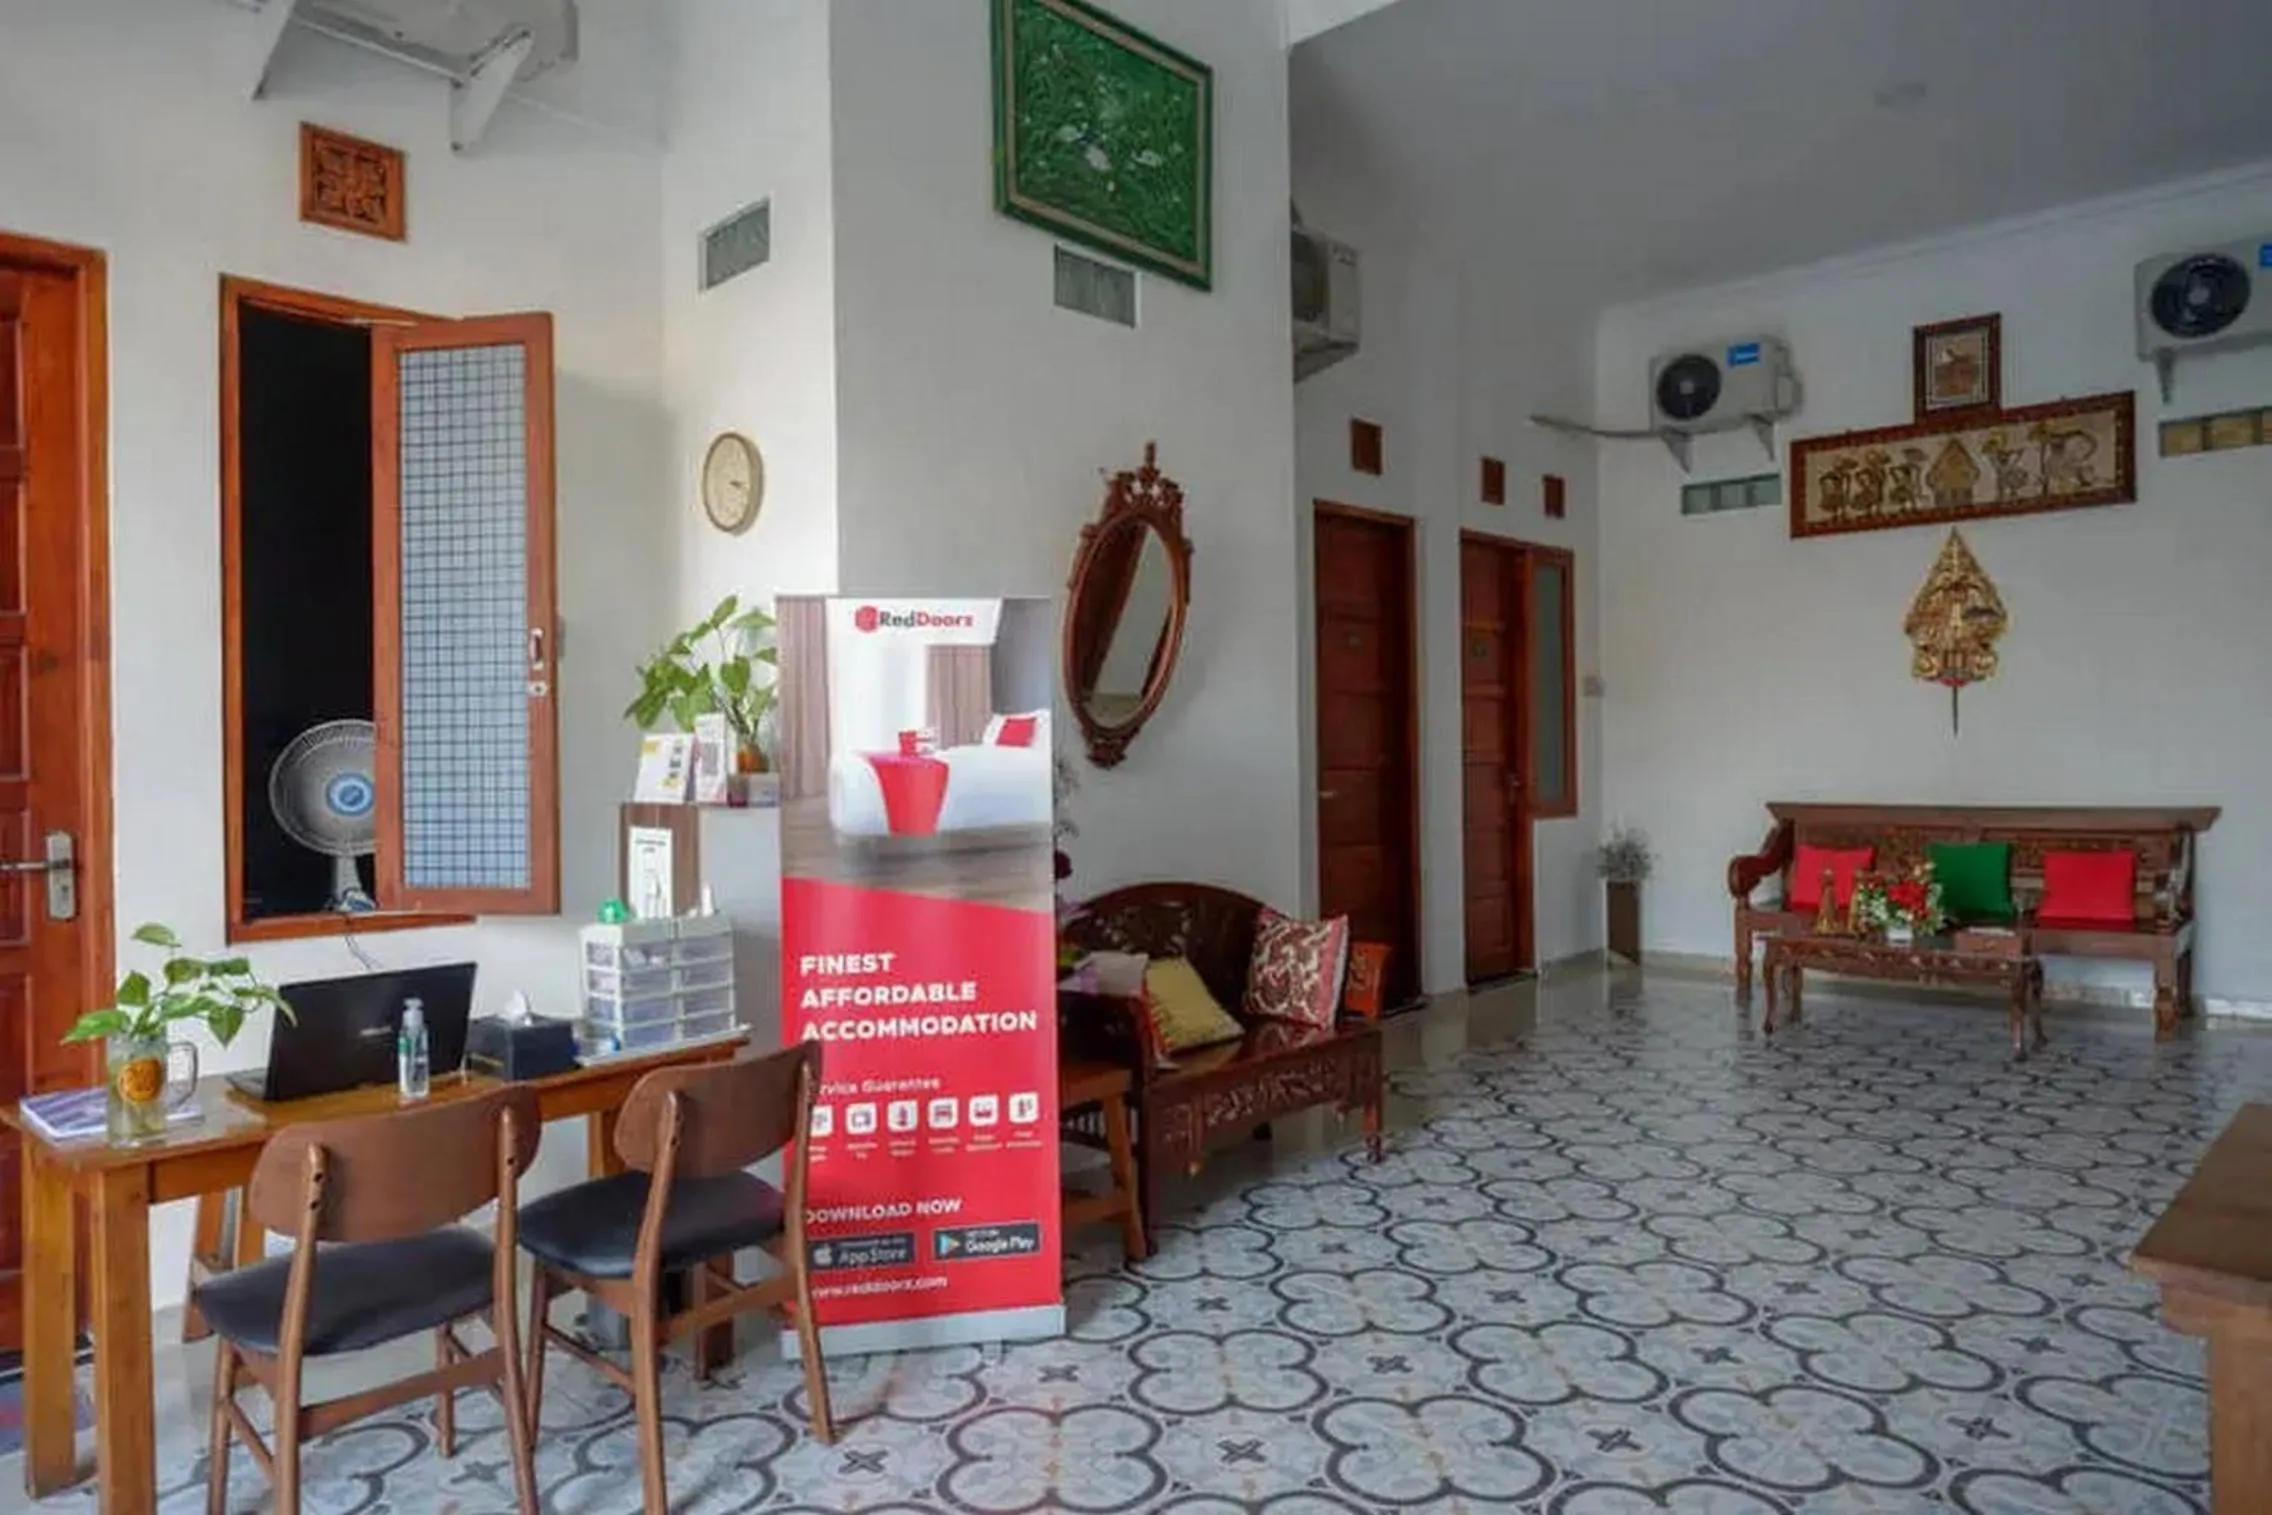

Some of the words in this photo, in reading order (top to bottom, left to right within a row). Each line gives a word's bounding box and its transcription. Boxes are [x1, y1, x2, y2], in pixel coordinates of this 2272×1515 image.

[801, 953, 894, 975] FINEST
[801, 982, 976, 1008] AFFORDABLE
[802, 1012, 1036, 1040] ACCOMMODATION
[820, 1081, 858, 1096] rvice
[916, 1198, 963, 1215] NOW
[965, 1238, 1008, 1254] Google
[1010, 1236, 1036, 1251] Play
[838, 1247, 869, 1265] App
[870, 1246, 906, 1263] Store
